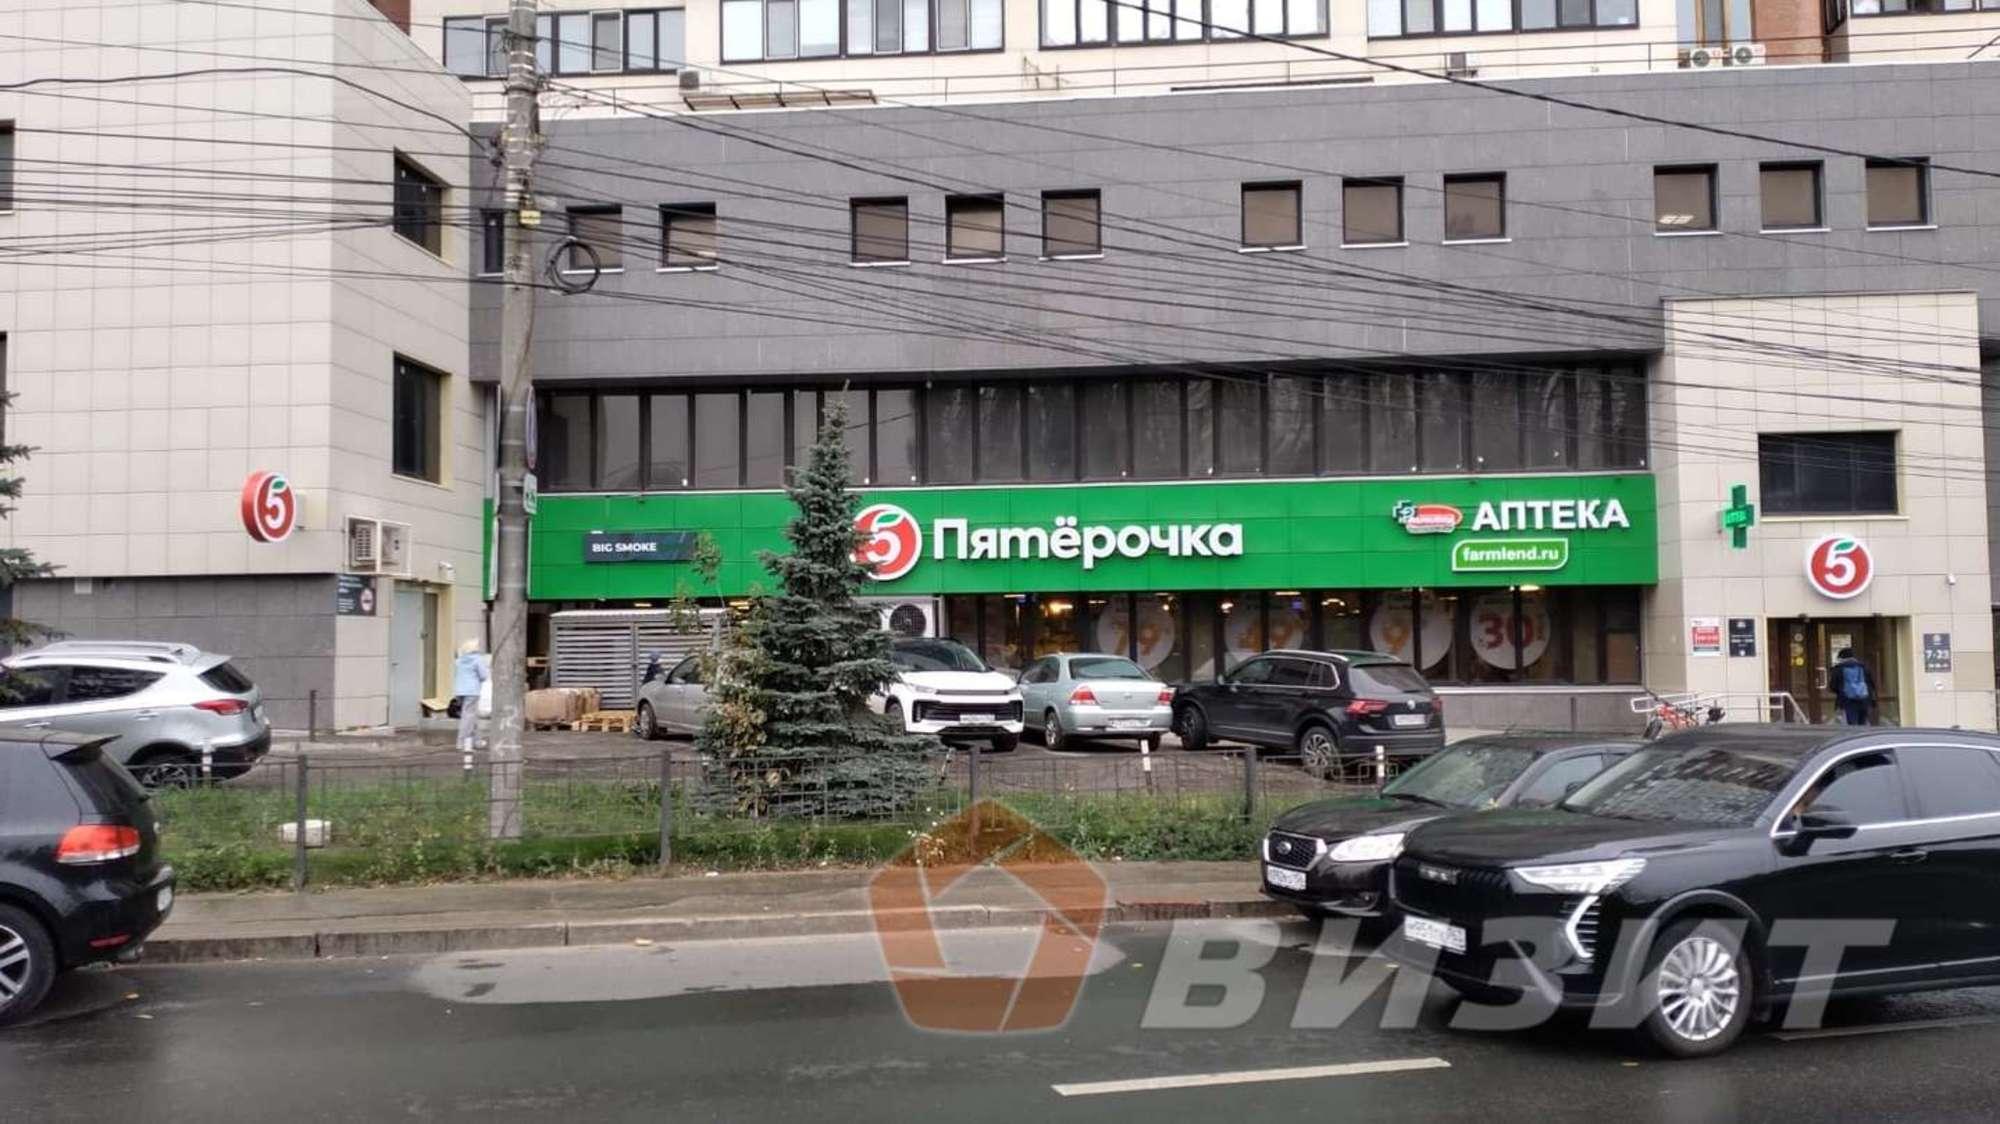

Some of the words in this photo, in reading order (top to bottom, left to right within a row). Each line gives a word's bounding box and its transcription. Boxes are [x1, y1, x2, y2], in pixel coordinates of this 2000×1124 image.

[265, 477, 288, 529] 5
[1472, 499, 1630, 531] АПТЕКА
[592, 543, 613, 553] BIG
[615, 542, 657, 553] SMOKE
[933, 516, 1244, 569] Пятёрочка
[1462, 547, 1560, 562] farmlend.ru
[1823, 539, 1857, 587] 5
[1477, 612, 1534, 650] 30
